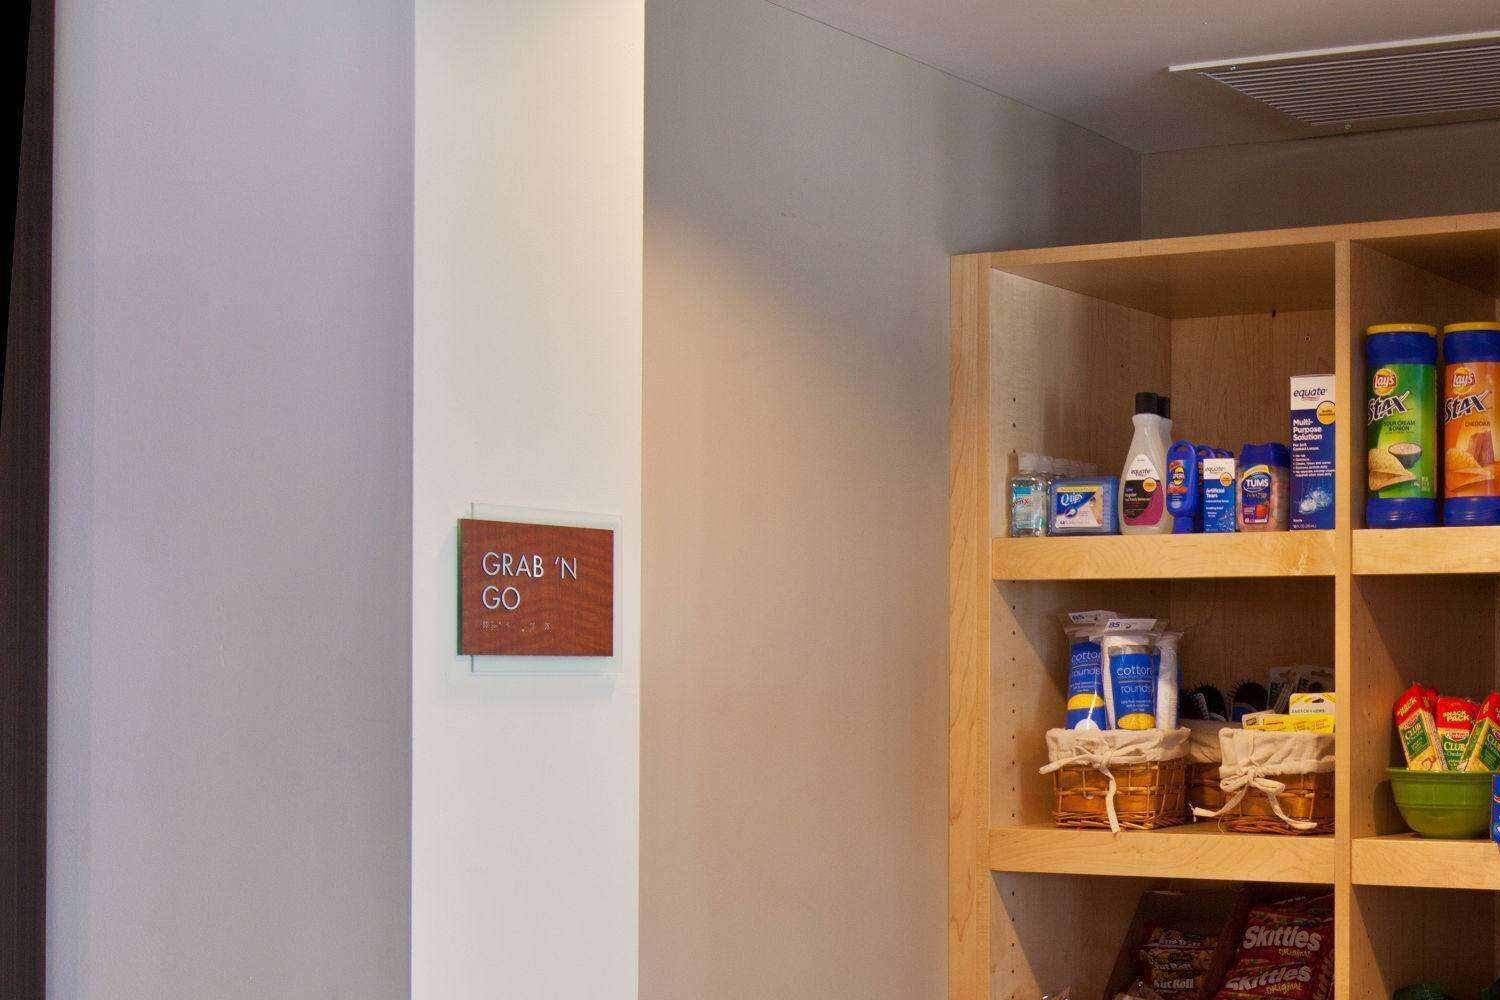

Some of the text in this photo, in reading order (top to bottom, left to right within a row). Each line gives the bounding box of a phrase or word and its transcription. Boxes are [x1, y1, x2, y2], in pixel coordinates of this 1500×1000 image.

[1294, 388, 1327, 398] equate
[1246, 479, 1269, 488] TUMS
[482, 552, 544, 578] GRAB
[482, 585, 521, 611] GO
[1243, 925, 1322, 951] Skittles
[1225, 965, 1312, 991] Skittles
